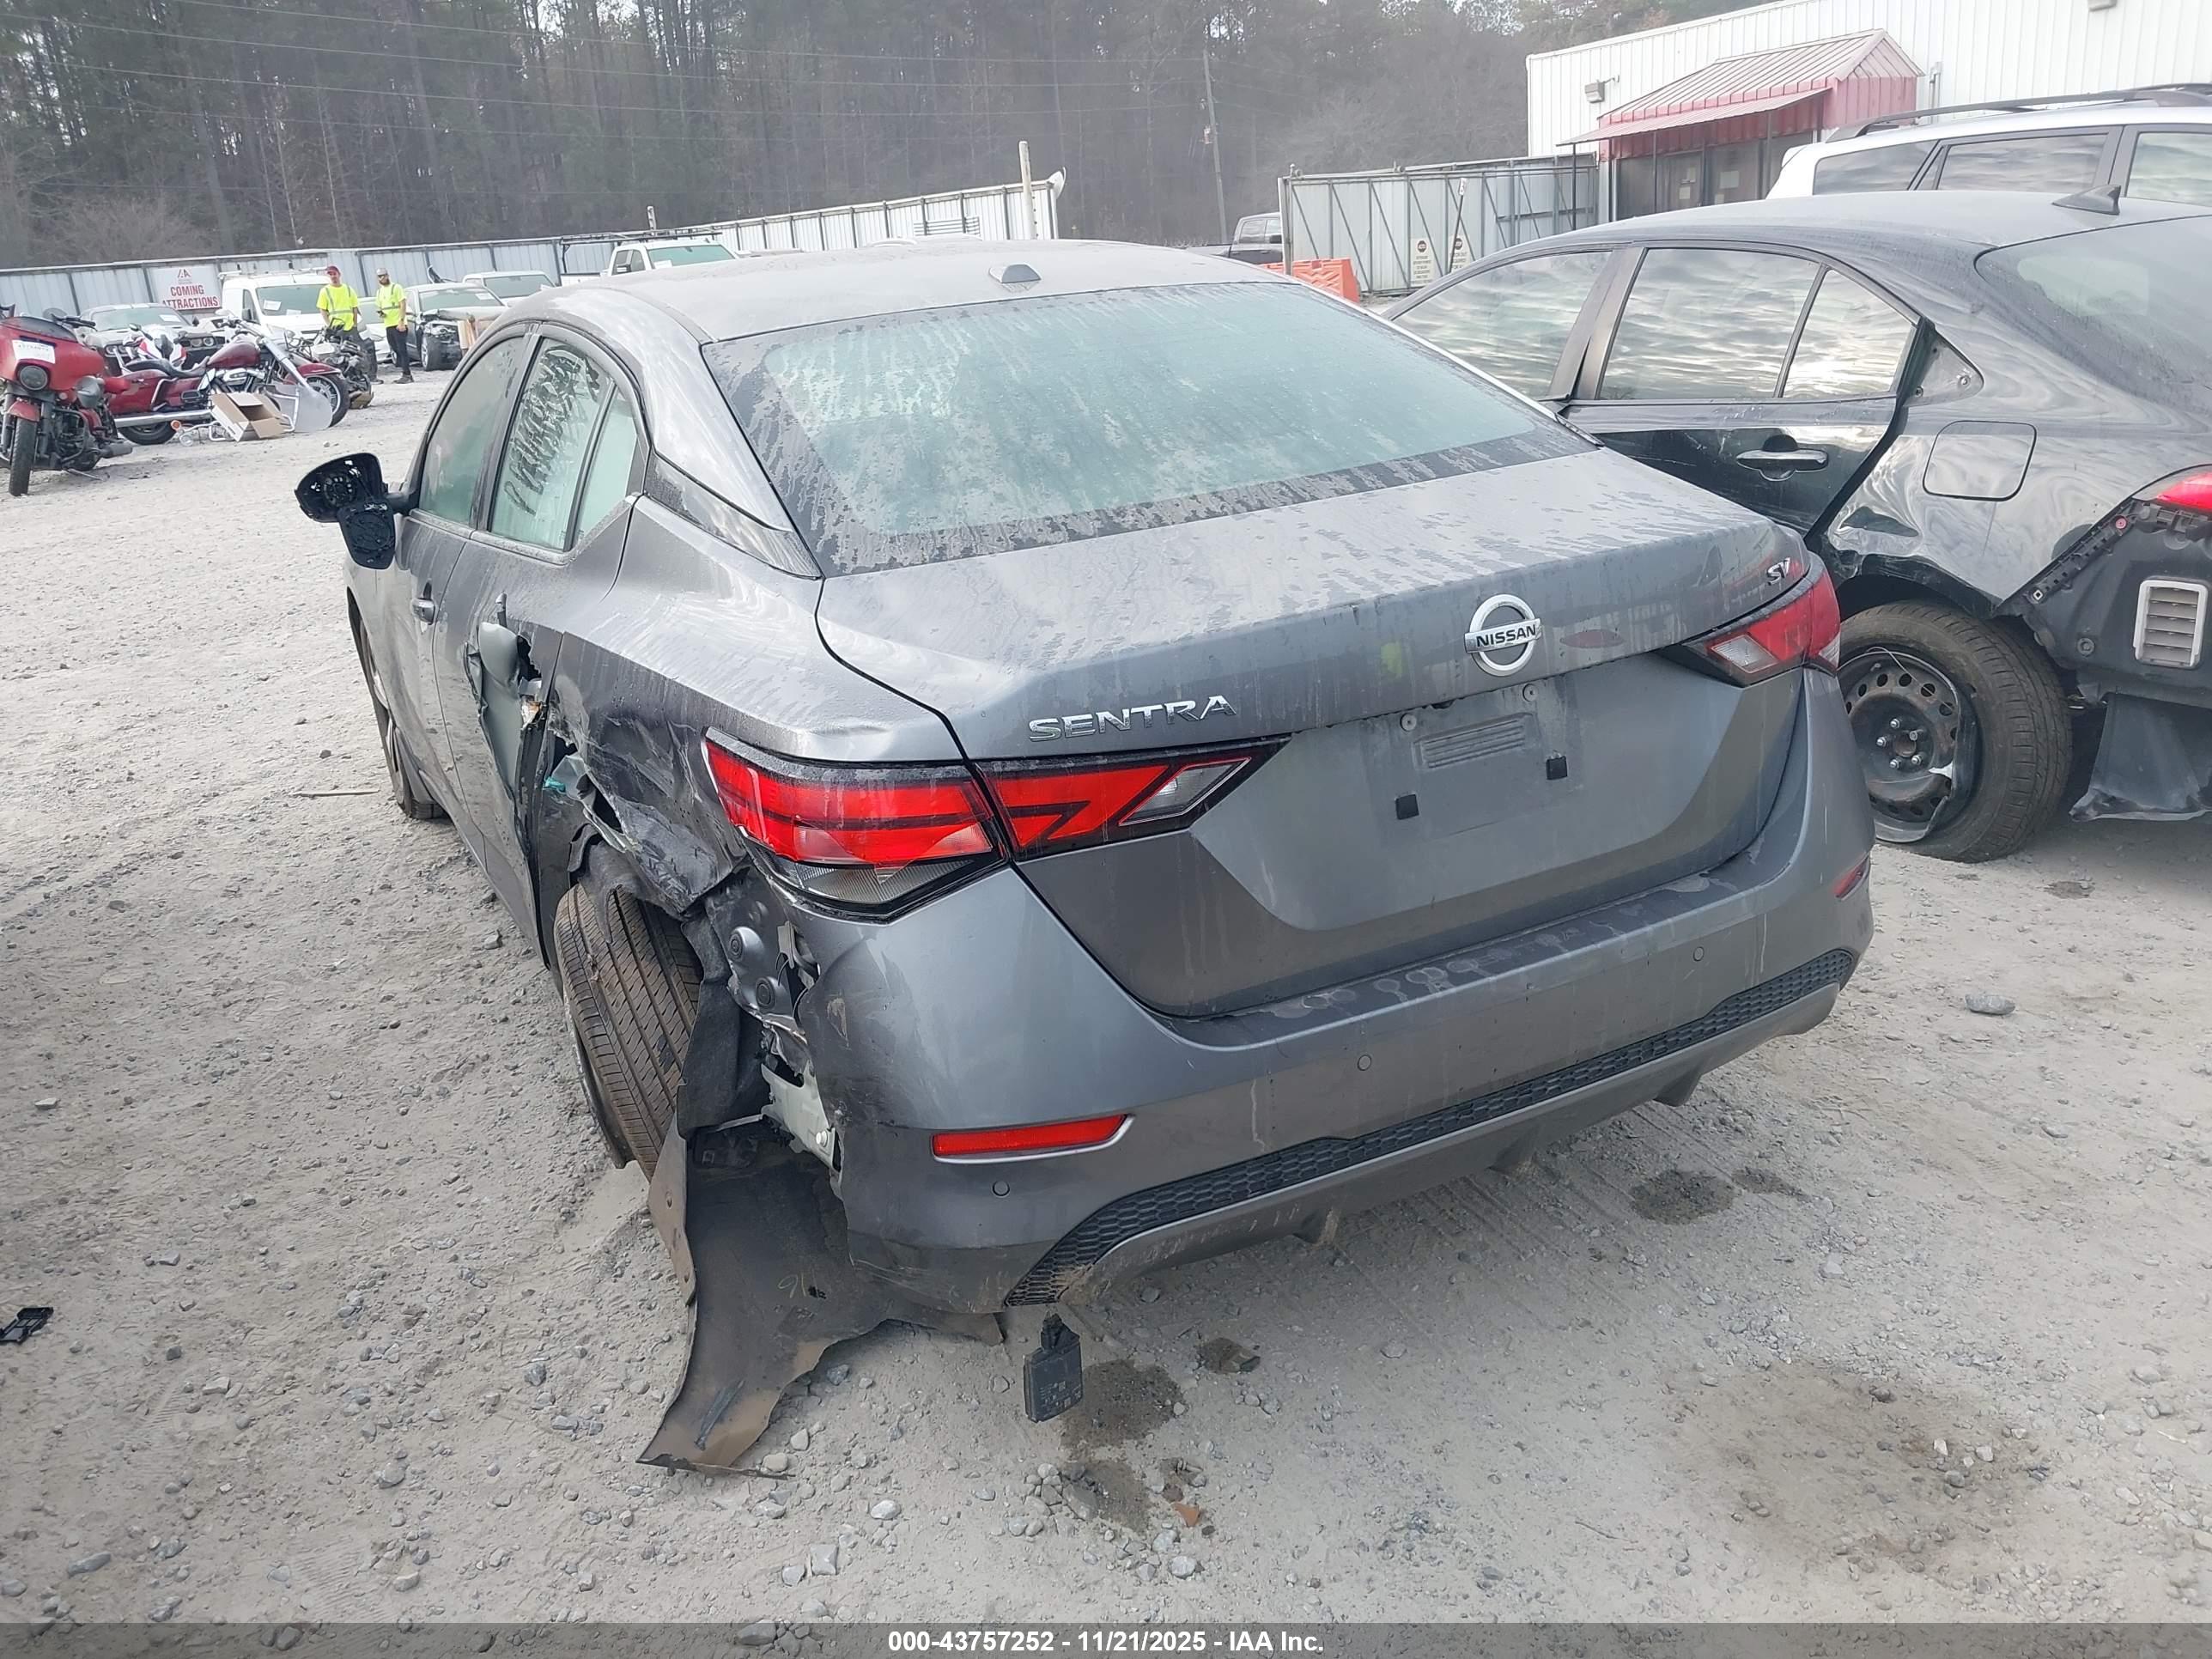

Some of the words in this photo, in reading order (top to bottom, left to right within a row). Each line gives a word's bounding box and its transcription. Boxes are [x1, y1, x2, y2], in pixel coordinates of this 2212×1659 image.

[170, 284, 204, 297] COMING
[163, 296, 219, 309] ATTRACTIONS
[1767, 557, 1790, 586] SV
[1476, 624, 1536, 647] NISSAN
[1028, 695, 1237, 742] SENTRA
